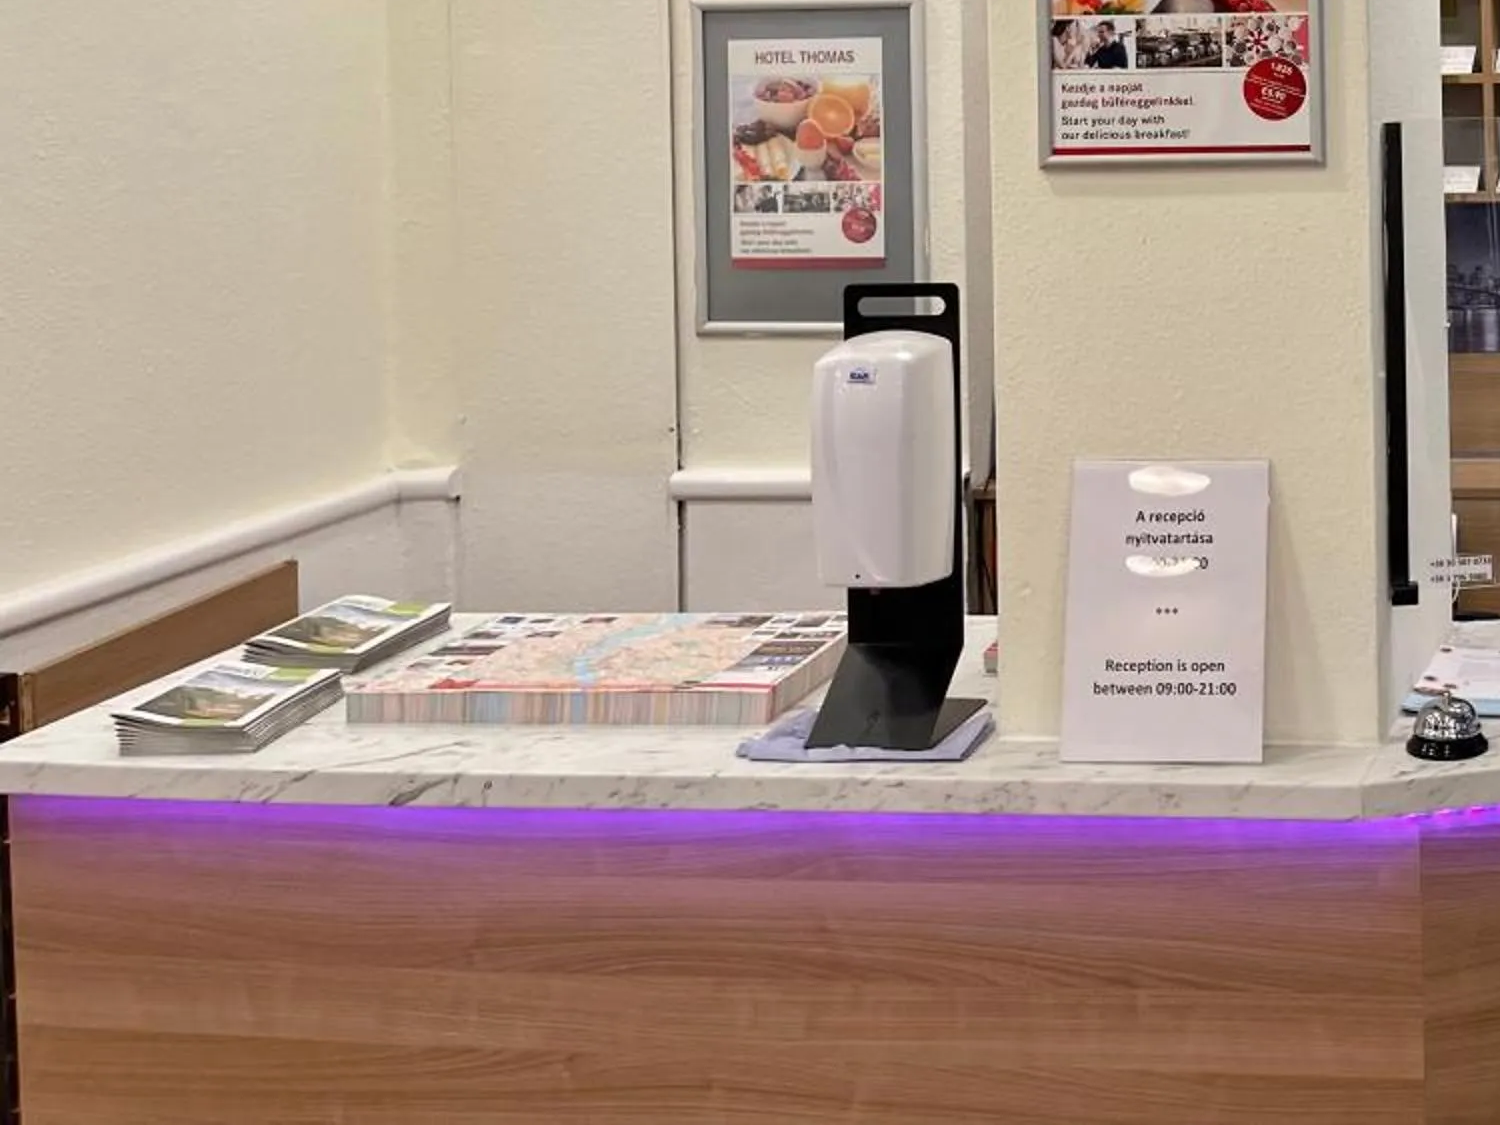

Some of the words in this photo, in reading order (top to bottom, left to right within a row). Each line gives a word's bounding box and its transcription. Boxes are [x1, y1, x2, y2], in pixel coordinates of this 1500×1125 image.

[755, 50, 796, 64] HOTEL
[800, 50, 855, 64] THOMAS
[1100, 84, 1105, 93] a
[1061, 116, 1089, 126] Start
[1091, 118, 1115, 128] your
[1117, 116, 1139, 128] day
[1141, 115, 1165, 125] with
[1061, 132, 1080, 140] our
[1082, 130, 1131, 140] delicious
[1136, 511, 1145, 522] A
[1149, 509, 1205, 525] recepció
[1125, 532, 1213, 547] nyitvatartása
[1105, 659, 1173, 674] Reception
[1177, 659, 1187, 672] is
[1191, 661, 1225, 674] open
[1093, 682, 1153, 696] between
[1155, 682, 1237, 696] 09:00-21:00
